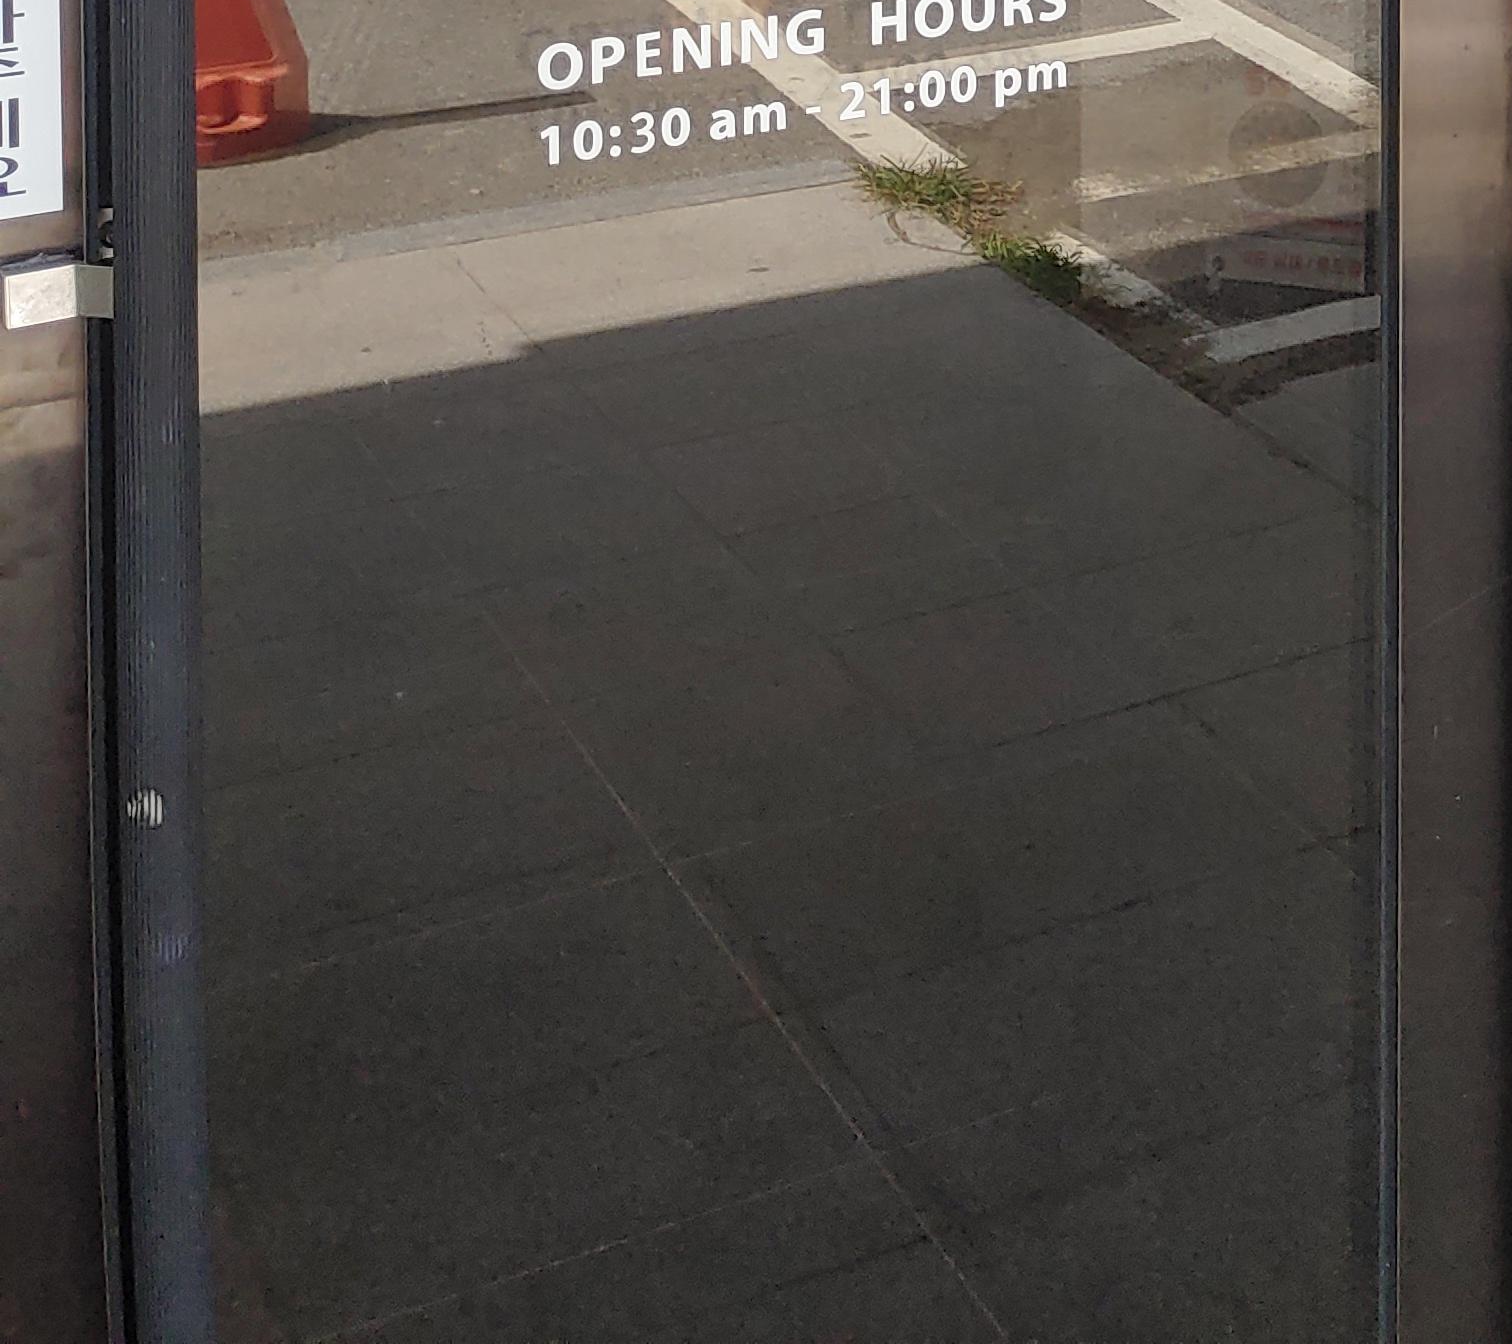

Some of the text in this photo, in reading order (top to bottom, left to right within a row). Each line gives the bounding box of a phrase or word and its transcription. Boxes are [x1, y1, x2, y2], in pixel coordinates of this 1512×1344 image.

[536, 8, 826, 93] OPENING
[539, 106, 692, 166] 10:30
[709, 97, 788, 142] am
[839, 64, 978, 122] 21:00
[995, 55, 1068, 108] pm
